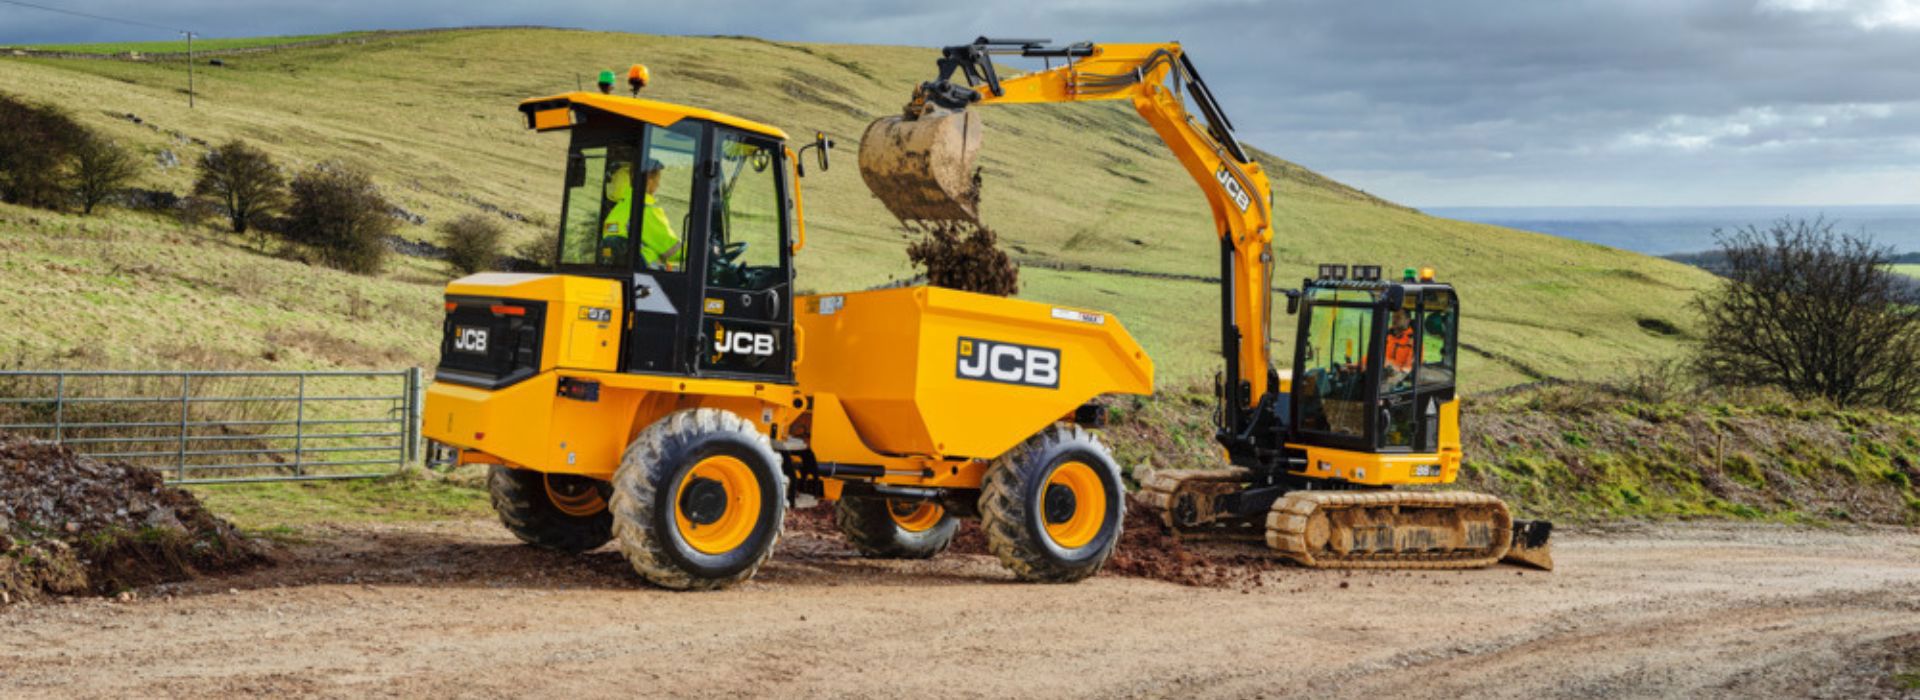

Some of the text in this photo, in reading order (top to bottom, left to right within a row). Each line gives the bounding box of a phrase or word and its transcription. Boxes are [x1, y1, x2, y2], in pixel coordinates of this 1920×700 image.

[1216, 169, 1249, 211] JCB
[455, 328, 487, 351] JCB
[714, 330, 774, 356] JCB
[959, 342, 1058, 385] JCB
